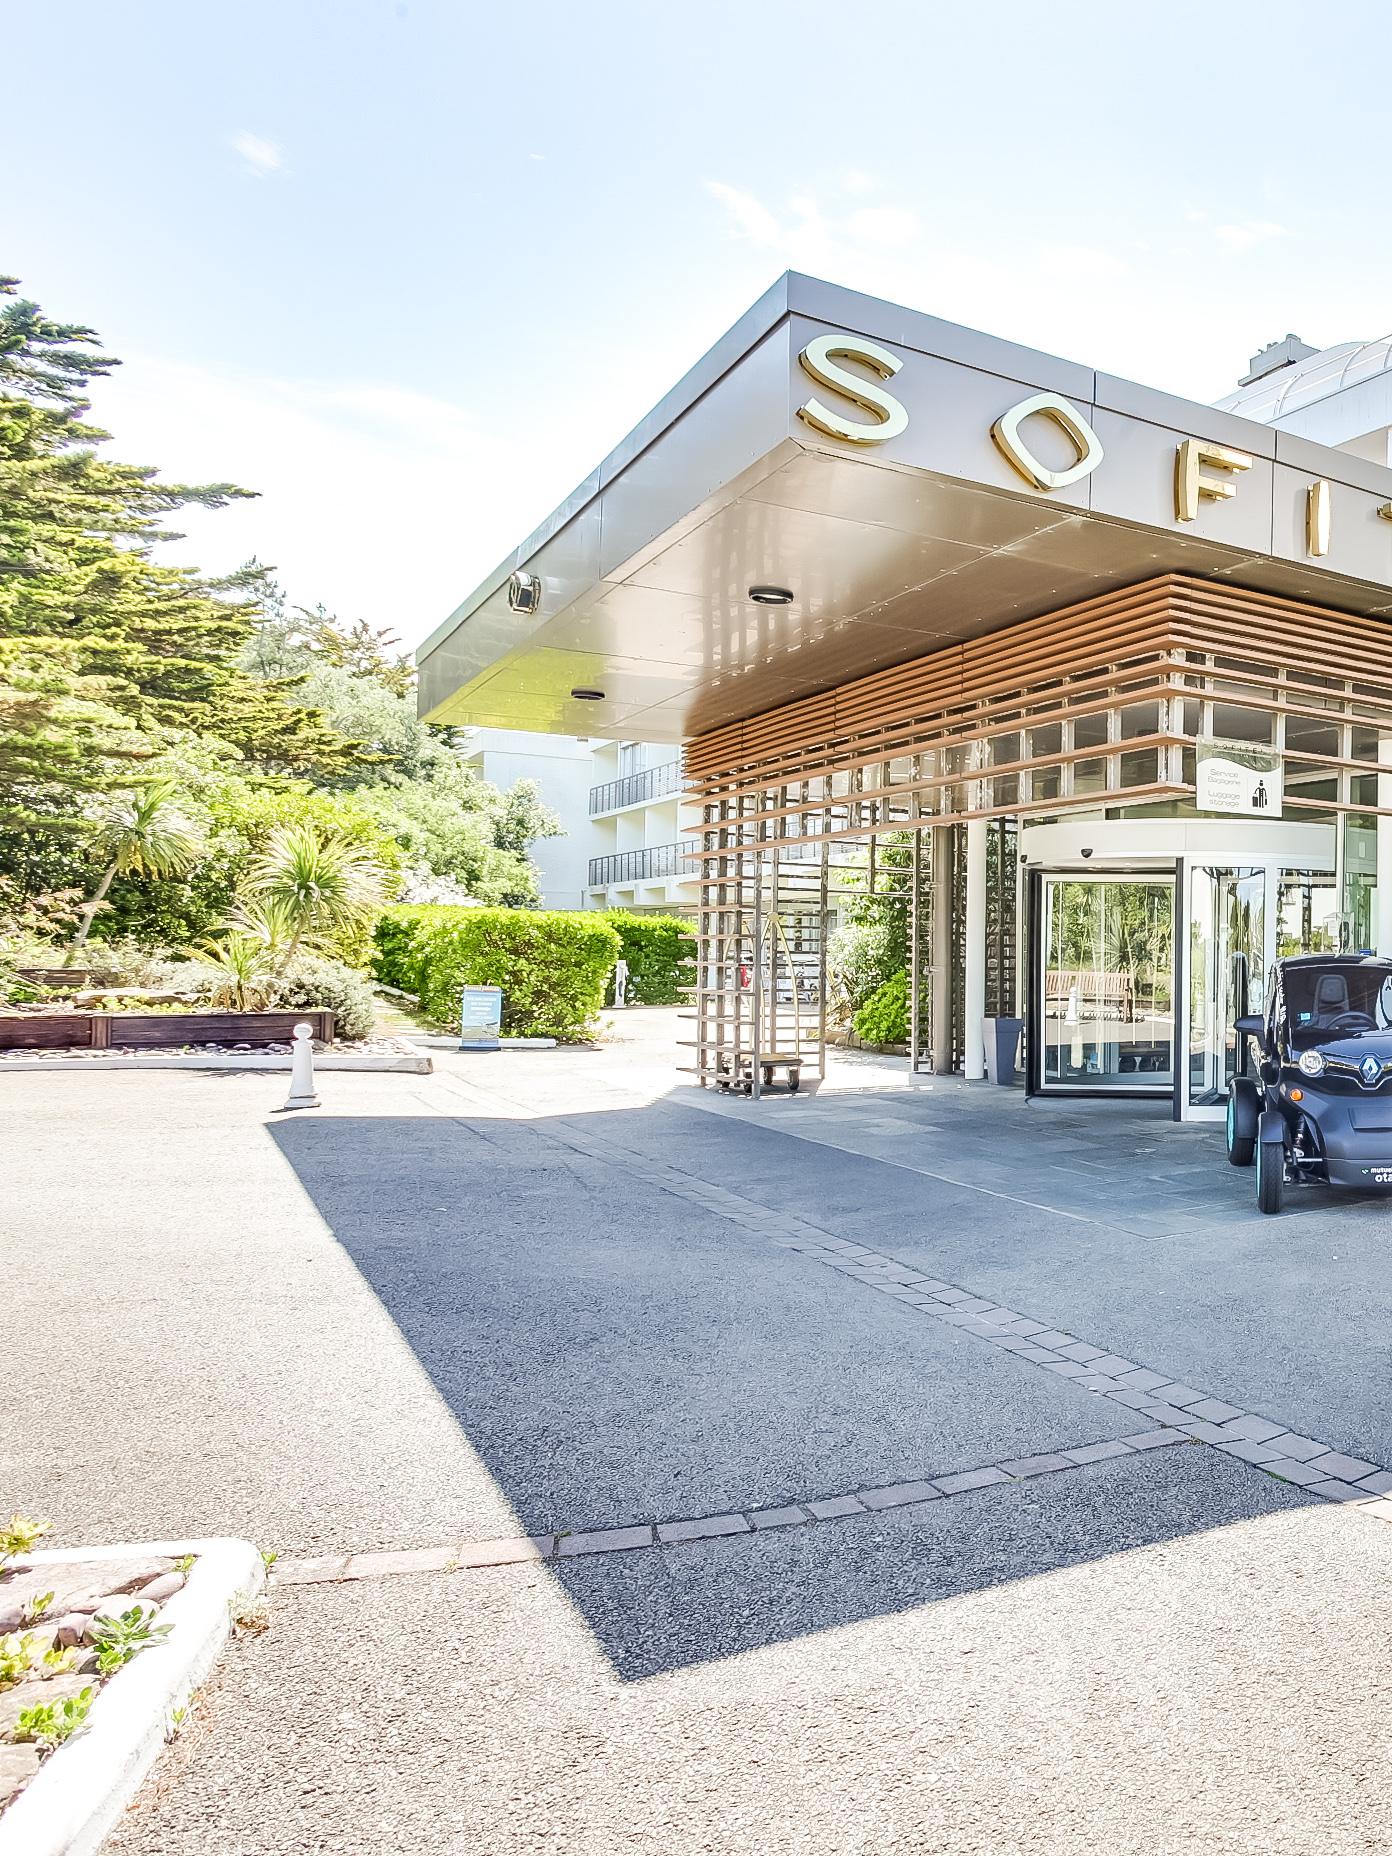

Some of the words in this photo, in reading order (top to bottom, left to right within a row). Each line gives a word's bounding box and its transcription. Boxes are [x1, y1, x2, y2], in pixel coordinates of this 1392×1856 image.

[1210, 768, 1239, 778] Service
[1208, 789, 1241, 800] Luggage
[1209, 799, 1240, 808] storage
